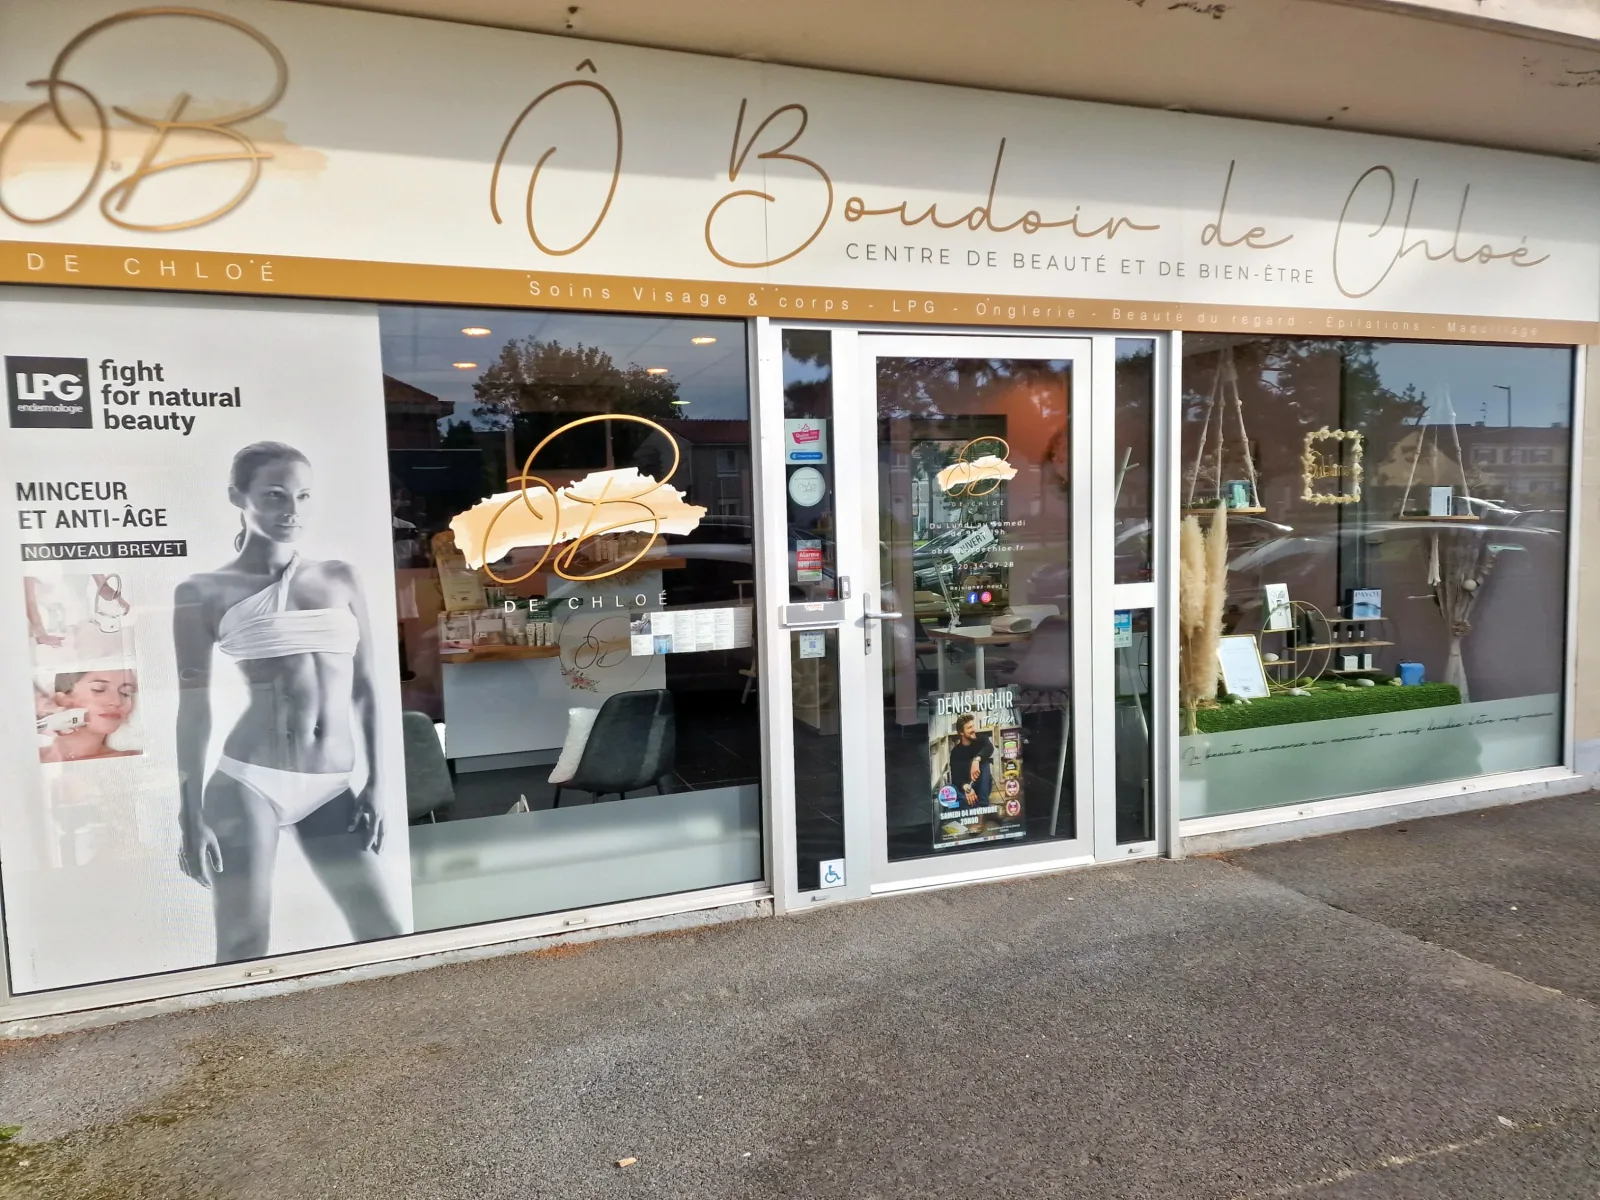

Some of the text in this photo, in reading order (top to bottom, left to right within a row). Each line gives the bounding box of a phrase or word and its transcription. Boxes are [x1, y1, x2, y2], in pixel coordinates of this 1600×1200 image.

[705, 97, 1160, 268] Boudoir
[1201, 159, 1294, 248] de
[1332, 165, 1550, 299] Chloé
[27, 252, 275, 282] DE CHLOÉ
[846, 243, 1315, 284] CENTRE DE BEAUTÉ ET DE BIEN-ÊTRE
[529, 280, 610, 299] Soins
[633, 286, 727, 307] Visage
[748, 292, 758, 306] &
[779, 295, 849, 311] corps
[893, 300, 935, 314] LPG
[976, 302, 1075, 319] Onglerie
[1112, 307, 1184, 323] Beauté
[1198, 312, 1218, 324] du
[1232, 314, 1295, 328] regard
[1325, 316, 1419, 331] Épilations
[99, 359, 165, 386] fight
[15, 372, 84, 402] LPG
[101, 384, 241, 408] for natural
[17, 403, 84, 414] endermologie
[103, 408, 196, 436] beauty
[15, 481, 129, 501] MINCEUR
[18, 505, 168, 530] ET ANTI-ÂGE
[929, 522, 942, 530] Du
[946, 521, 974, 529] Lundi
[992, 520, 1026, 528] Samedi
[24, 542, 184, 559] NOUVEAU BREVET
[504, 599, 539, 613] DE
[568, 590, 668, 610] CHLOÉ
[937, 691, 1014, 716] DENIS RICHIR
[940, 811, 961, 820] SAMEDI
[969, 806, 998, 816] NOVEMBRE
